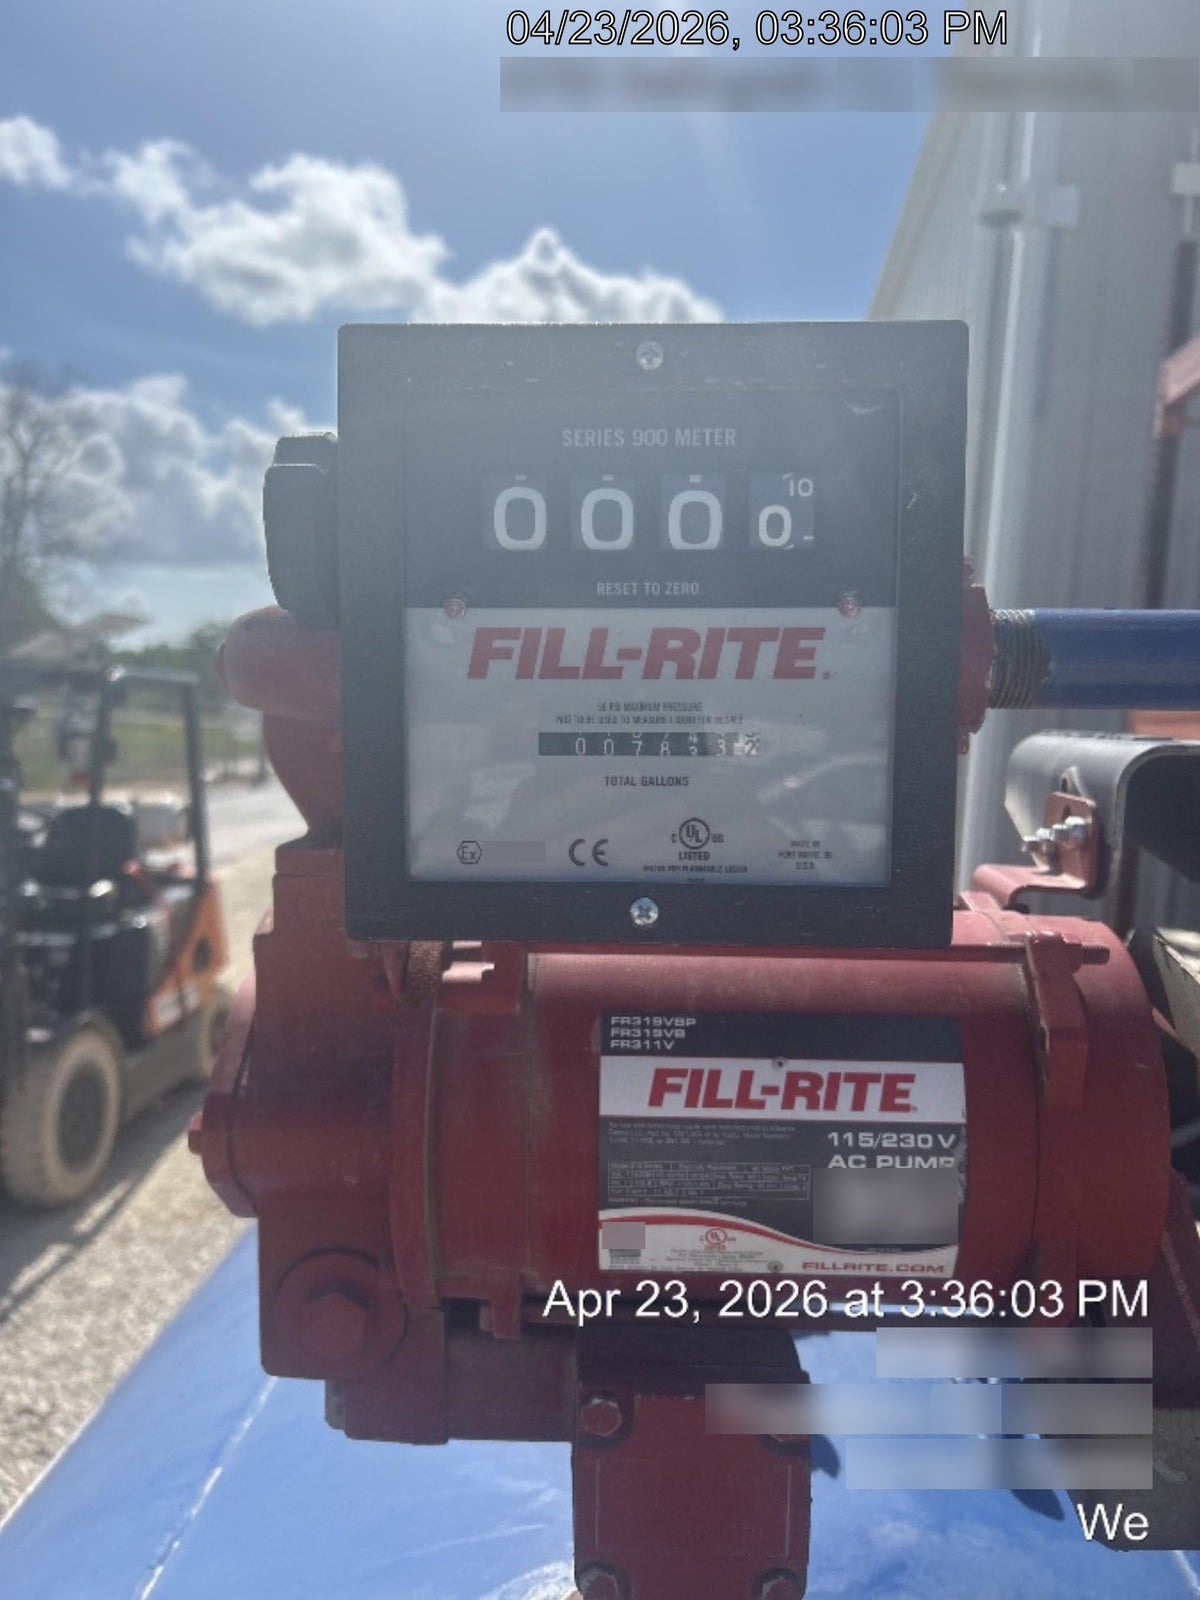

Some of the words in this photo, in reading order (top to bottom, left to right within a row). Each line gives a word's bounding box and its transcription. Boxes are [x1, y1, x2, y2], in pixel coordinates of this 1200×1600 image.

[562, 428, 625, 448] SERIES
[632, 428, 668, 447] 900
[675, 428, 737, 447] METER
[596, 581, 638, 596] RESET
[643, 581, 661, 596] TO
[665, 581, 700, 596] ZERO
[466, 627, 827, 680] FILL-RITE
[604, 776, 637, 788] TOTAL
[640, 776, 690, 788] GALLONS
[679, 851, 711, 861] LISTED
[611, 1039, 675, 1050] FR311V
[648, 1067, 917, 1113] FILL-RITE
[828, 1132, 933, 1149] 115/230
[937, 1134, 957, 1149] V
[828, 1155, 867, 1169] AC
[876, 1155, 957, 1169] PUMP
[802, 1261, 945, 1273] FILLRITE.COM
